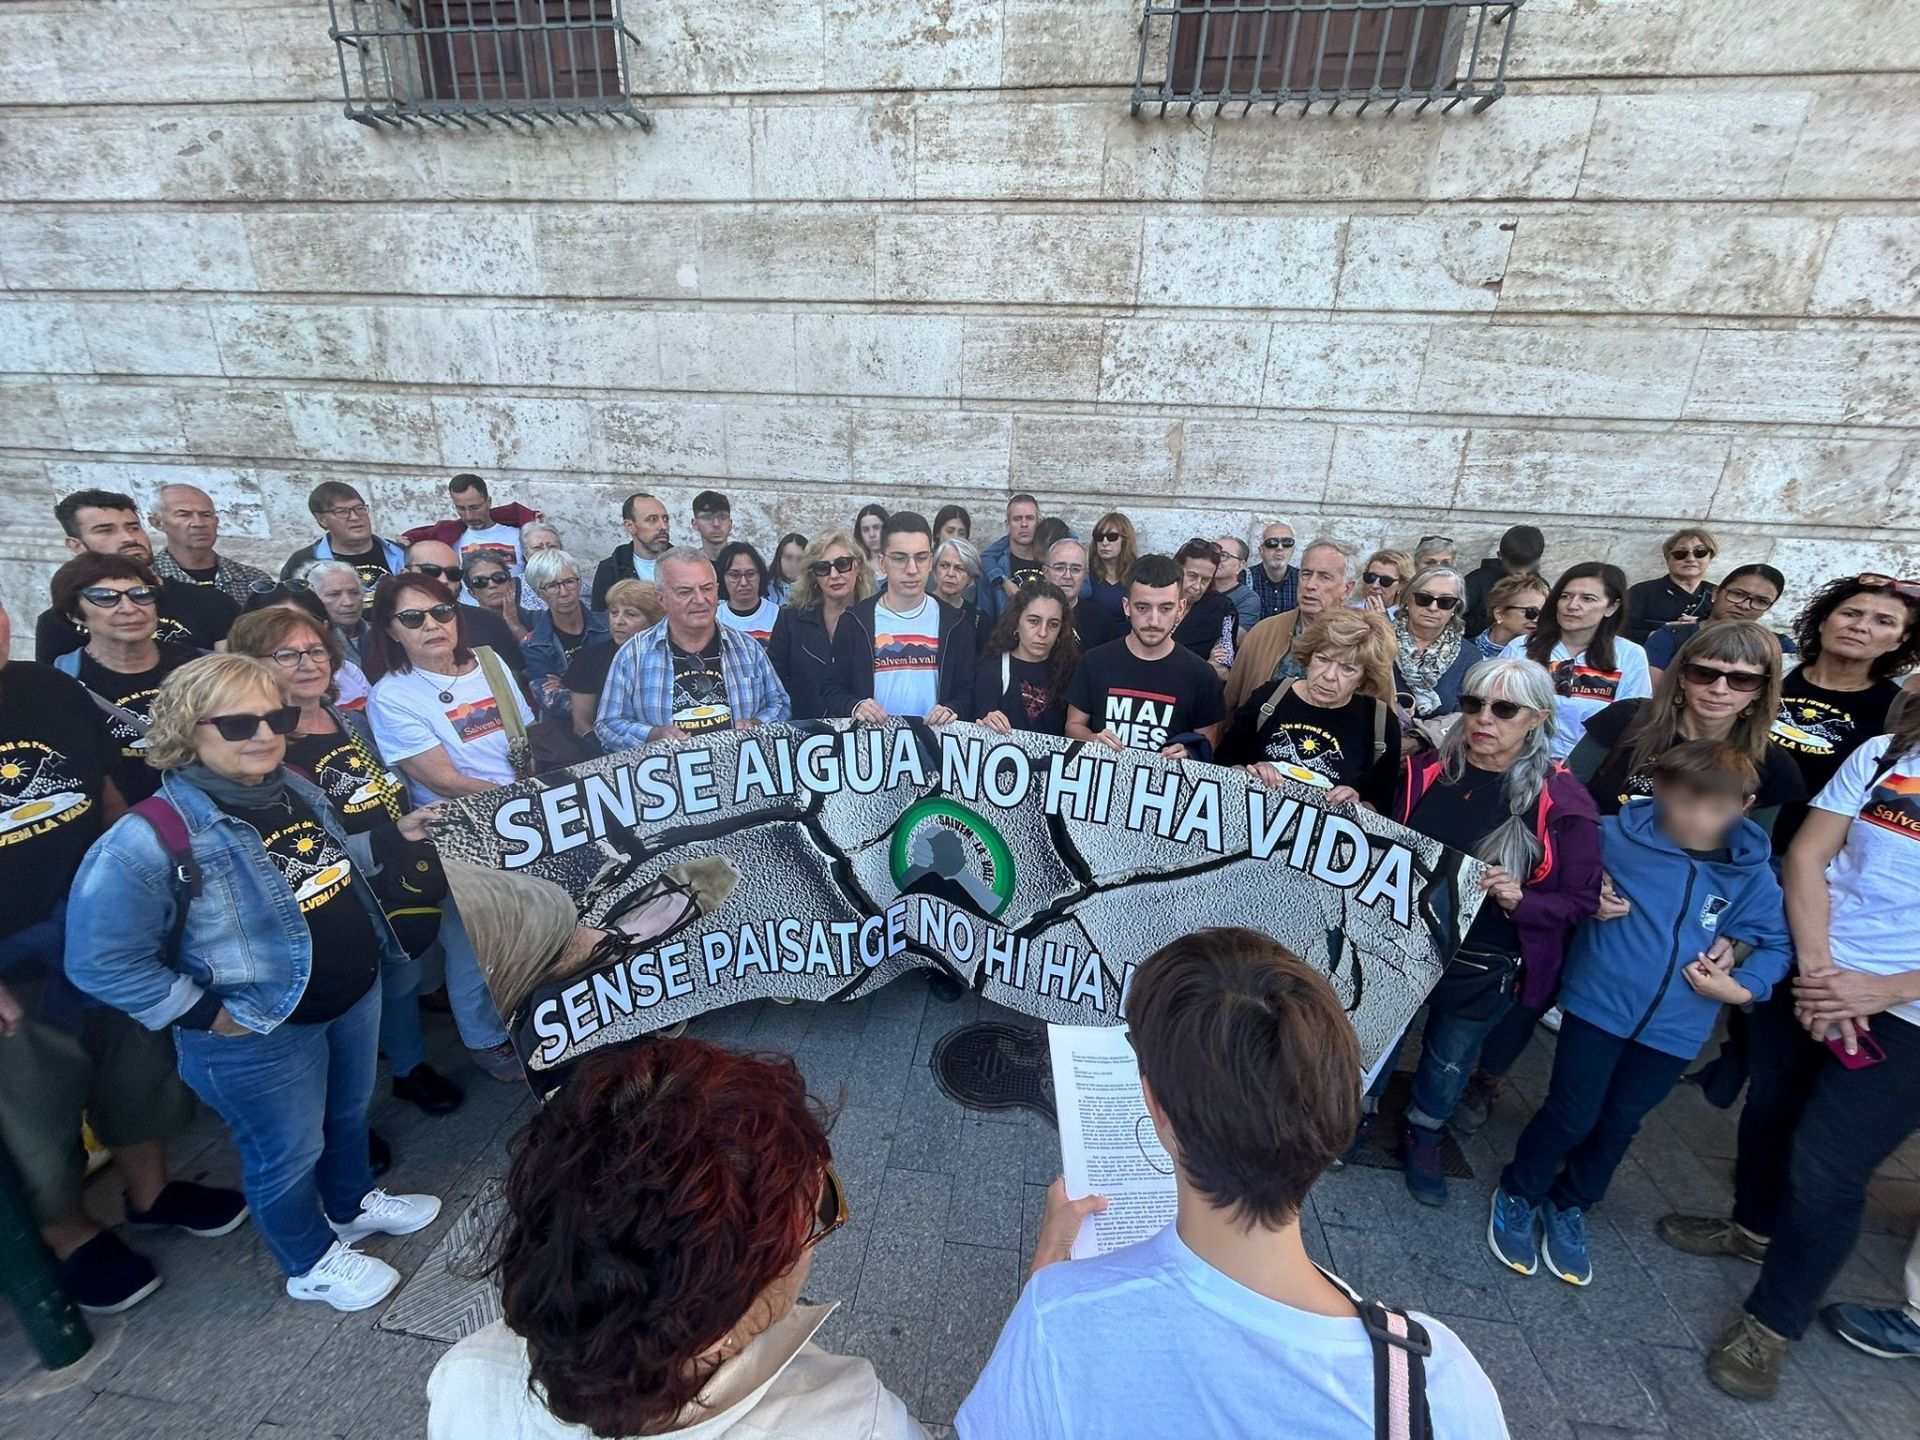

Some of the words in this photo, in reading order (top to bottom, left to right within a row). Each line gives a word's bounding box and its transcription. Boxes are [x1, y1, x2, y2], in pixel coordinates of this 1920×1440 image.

[874, 655, 908, 668] Salvem
[908, 655, 917, 664] la
[919, 654, 937, 664] vall
[1581, 685, 1591, 694] la
[1593, 687, 1613, 697] vall
[675, 720, 699, 729] LVEM
[701, 718, 713, 727] LA
[1106, 696, 1175, 727] MAI
[464, 721, 495, 736] Salvem
[1106, 721, 1168, 751] MES
[1778, 738, 1797, 750] LA
[1800, 744, 1836, 755] VALL
[343, 797, 381, 814] SALVEM
[1873, 804, 1920, 831] Salve
[0, 827, 33, 847] VEM
[32, 819, 60, 835] LA
[57, 799, 92, 823] VALL
[494, 750, 719, 868] SENSE
[735, 729, 926, 802] AIGUA
[941, 732, 1030, 808] NO
[1044, 752, 1116, 825] HI
[1126, 765, 1224, 854] HA
[1248, 791, 1413, 929] VIDA
[939, 814, 974, 839] SALVEM
[973, 842, 987, 855] LA
[981, 860, 994, 882] VALL
[300, 891, 331, 913] LVEM
[329, 884, 341, 898] LA
[533, 942, 695, 1063] SENSE
[702, 899, 908, 984] PAISATGE
[918, 898, 975, 962] NO
[984, 926, 1030, 990] HI
[1038, 941, 1106, 1013] HA
